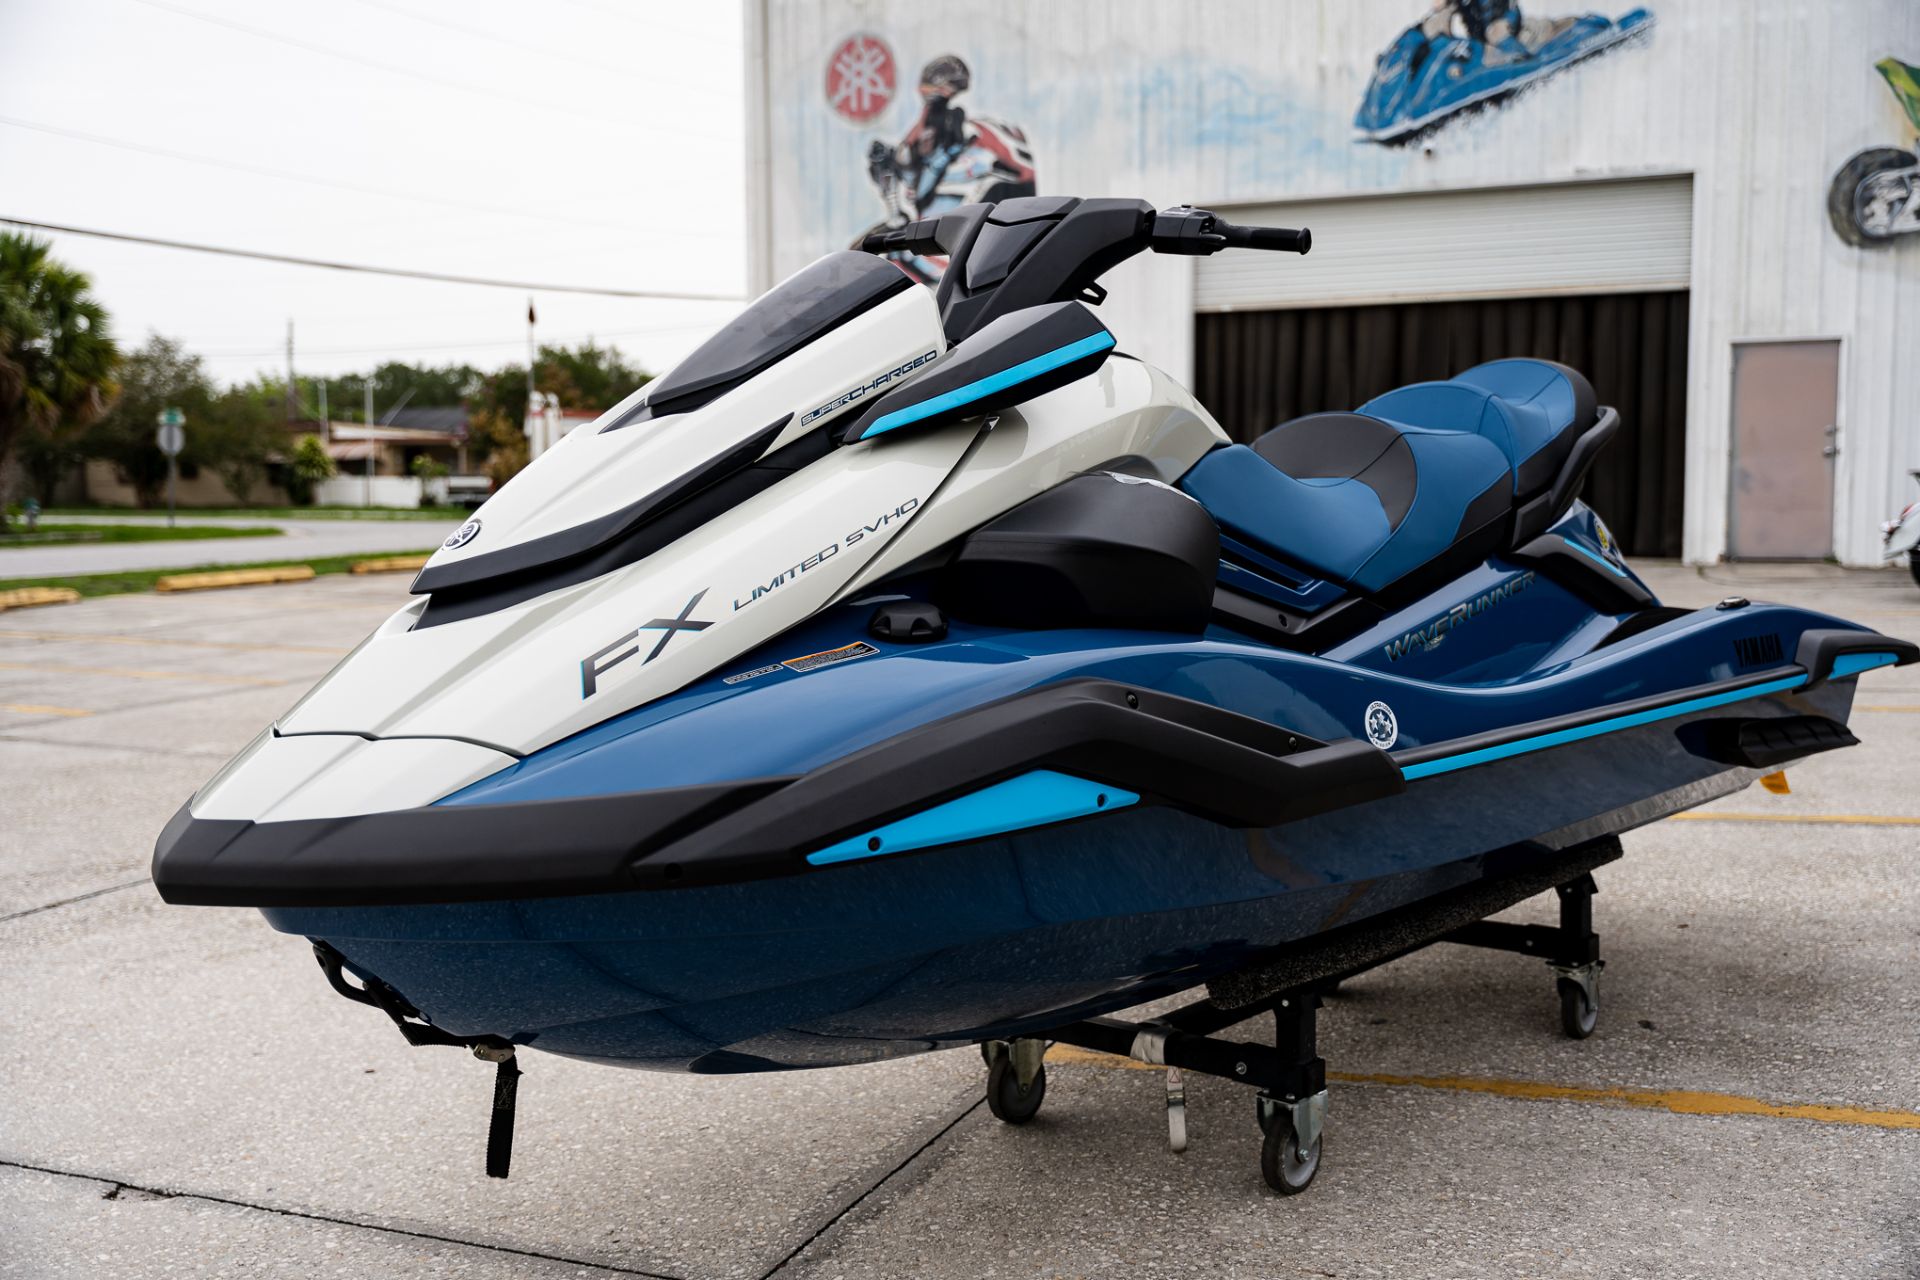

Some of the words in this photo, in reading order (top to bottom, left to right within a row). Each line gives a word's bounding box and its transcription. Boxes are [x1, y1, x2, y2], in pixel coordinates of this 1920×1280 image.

[800, 349, 937, 427] SUPERCHARGED
[733, 543, 839, 611] LIMITED
[846, 497, 919, 547] SVHO
[581, 587, 716, 701] FX
[1384, 571, 1537, 663] WAVERUNNER
[1733, 633, 1785, 668] YAMAHA
